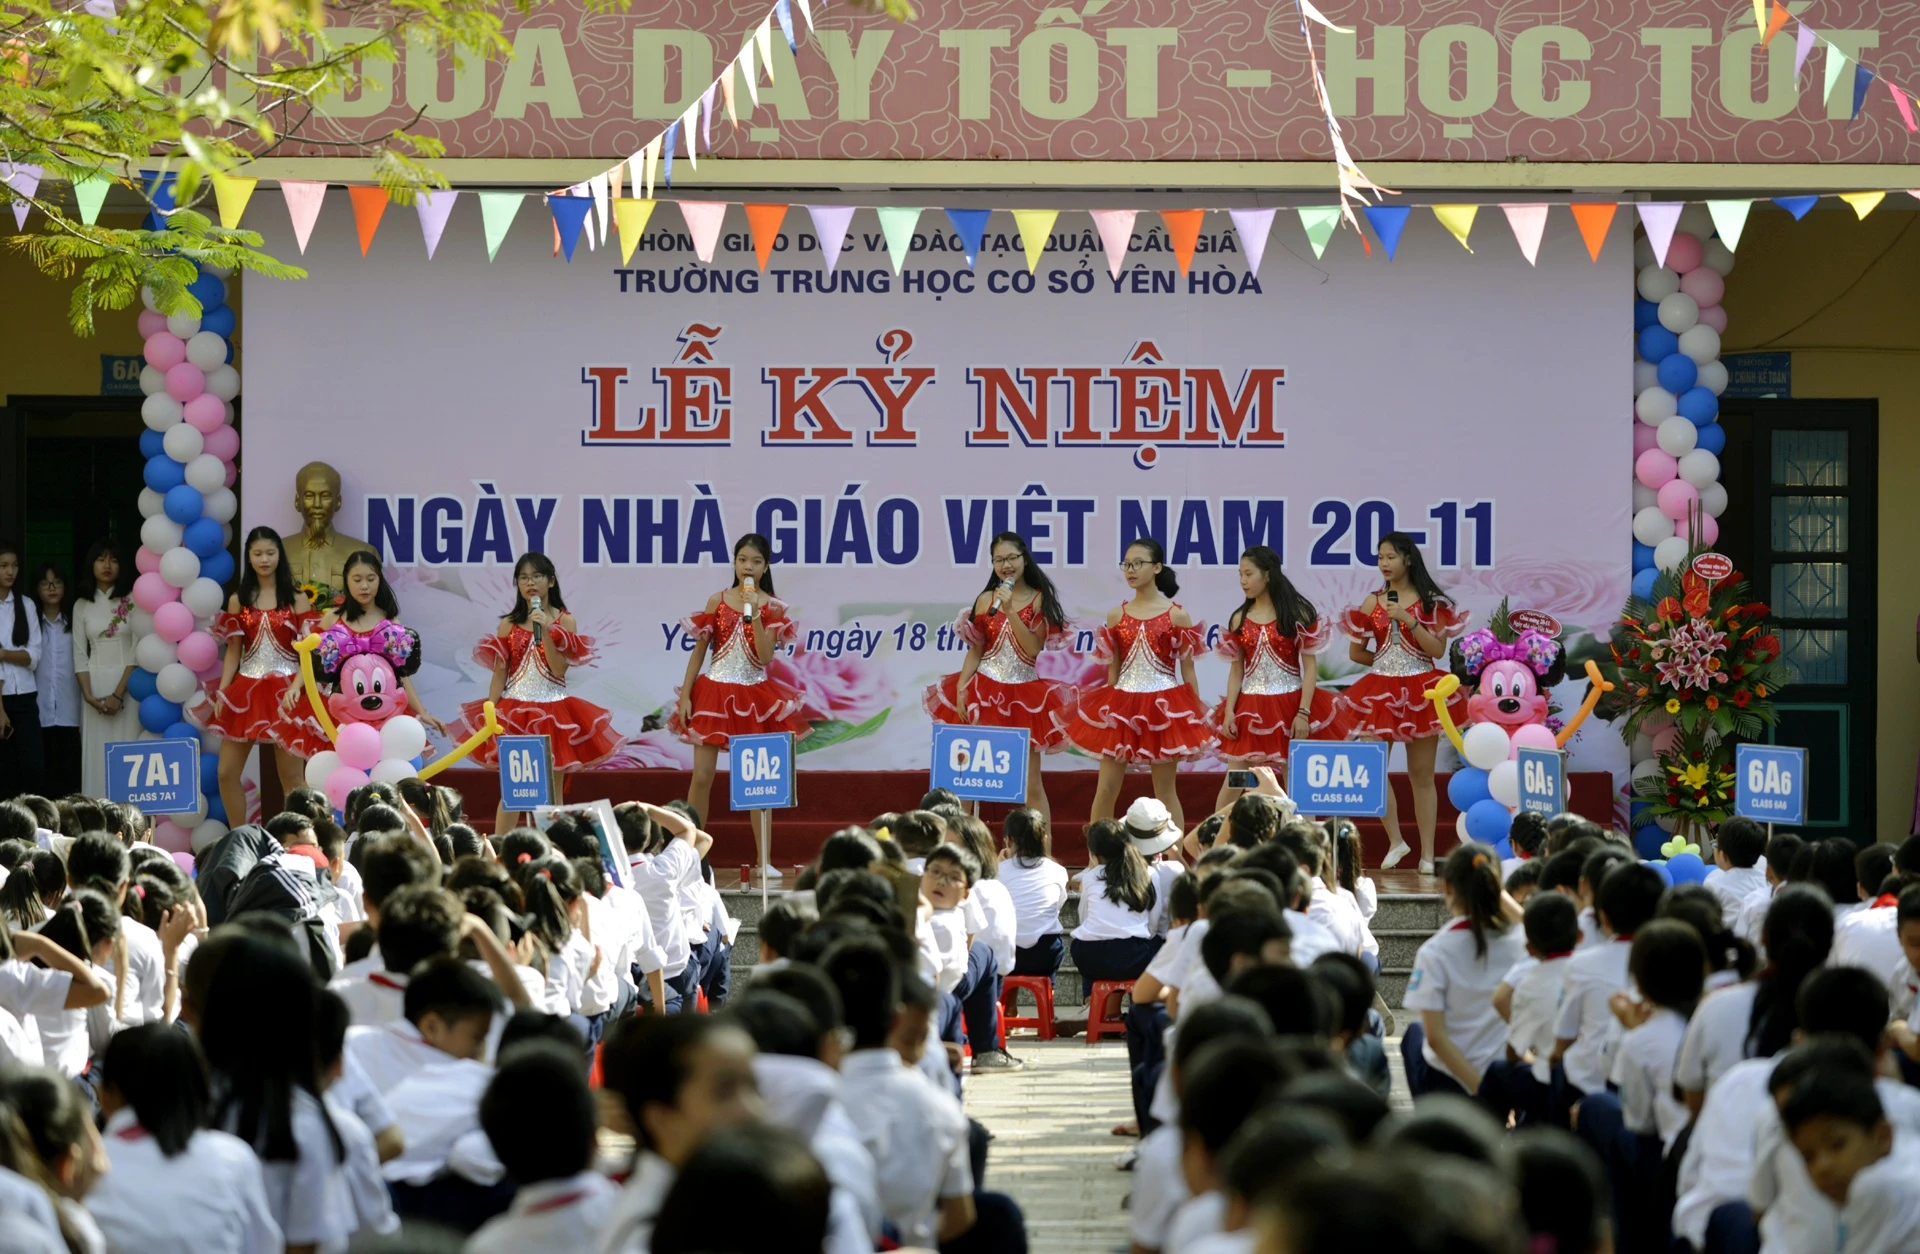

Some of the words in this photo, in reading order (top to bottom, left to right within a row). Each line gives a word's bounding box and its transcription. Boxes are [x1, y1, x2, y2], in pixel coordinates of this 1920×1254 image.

[632, 28, 893, 142] DẠY
[939, 0, 1178, 120] TỐT
[1226, 69, 1272, 88] -
[1323, 24, 1591, 138] HỌC
[1641, 0, 1879, 120] TỐT
[723, 233, 789, 252] GIO
[798, 233, 855, 252] DC
[614, 262, 759, 294] TRƯỜNG
[771, 269, 890, 294] TRUNG
[903, 269, 975, 301] HỌC
[1047, 259, 1095, 294] SỞ
[1106, 264, 1176, 294] YÊN
[1188, 264, 1263, 295] HÒA
[581, 322, 732, 448] LỄ
[761, 328, 936, 448] KỶ
[965, 340, 1285, 470] NIỆM
[366, 482, 558, 565] NGÀY
[582, 482, 730, 565] NHÀ
[755, 482, 920, 565] GIÁO
[1119, 498, 1285, 566] NAM
[1310, 499, 1493, 567] 20-11
[806, 621, 883, 659] ngày
[893, 622, 928, 652] 18
[123, 752, 180, 788] 7A1
[509, 749, 540, 783] 6A1
[741, 747, 781, 782] 6A2
[949, 738, 1011, 774] 6A3
[1307, 754, 1370, 788] 6A4
[513, 788, 529, 798] CLASS
[530, 789, 538, 797] 6A1
[744, 786, 765, 796] CLASS
[765, 786, 777, 795] 6A2
[953, 777, 983, 787] CLASS
[985, 779, 1004, 789] 6A3
[1523, 760, 1554, 796] 6A5
[1748, 759, 1792, 795] 6A6
[128, 792, 158, 803] CLASS
[160, 792, 176, 801] 7A1
[1311, 793, 1342, 803] CLASS
[1344, 794, 1364, 803] 6A4
[1525, 799, 1542, 811] CLASS
[1751, 798, 1773, 809] CLASS
